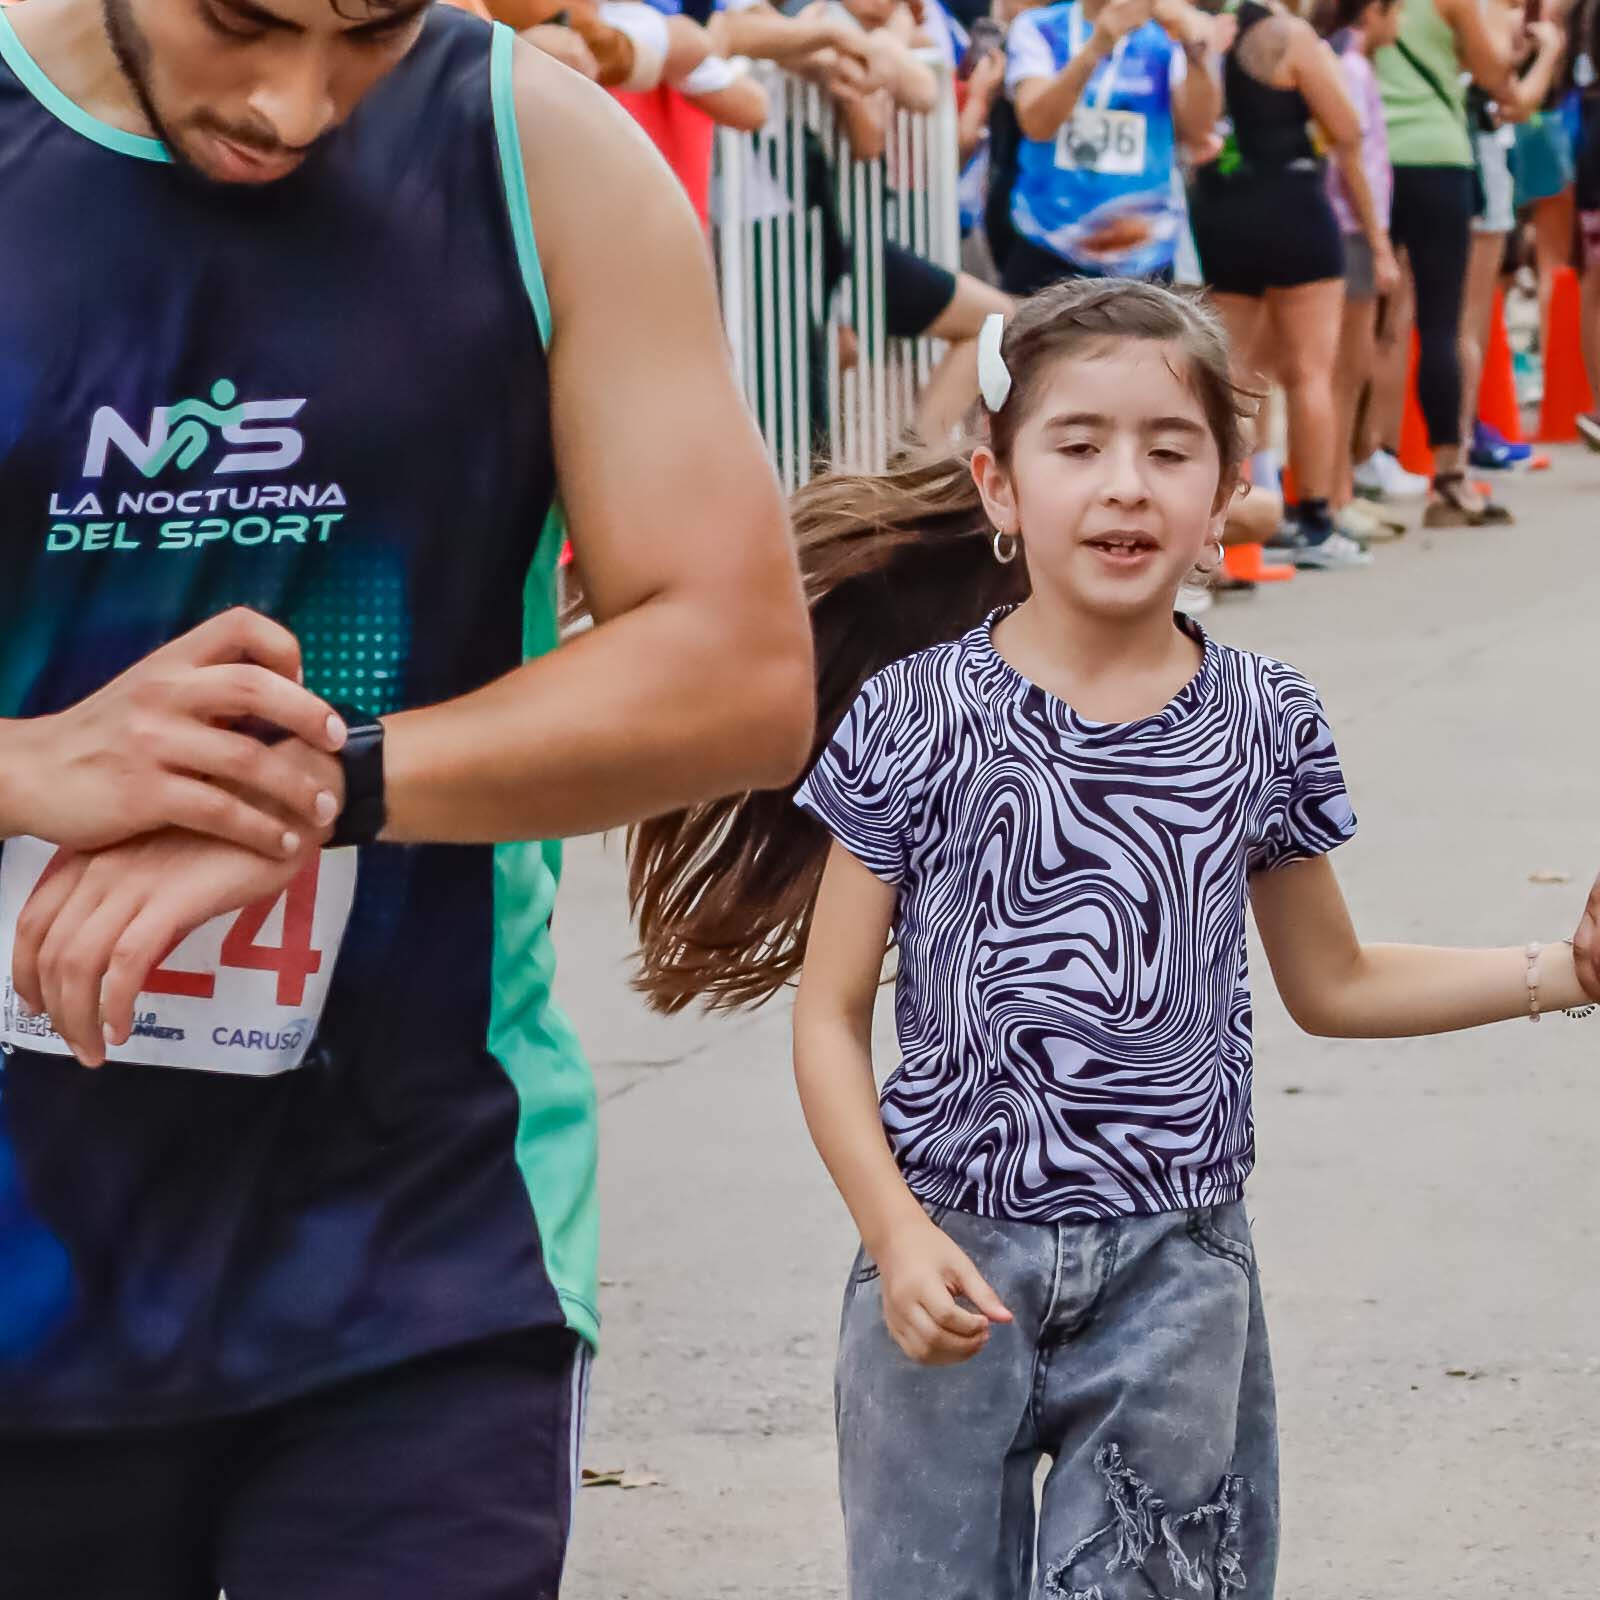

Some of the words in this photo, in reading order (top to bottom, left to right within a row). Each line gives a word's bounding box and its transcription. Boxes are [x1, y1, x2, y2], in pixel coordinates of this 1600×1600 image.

[48, 492, 104, 515] LA
[116, 483, 347, 515] NOCTURNA
[46, 521, 141, 551] DEL
[158, 513, 345, 550] SPORT
[212, 1026, 303, 1051] CARUSO
